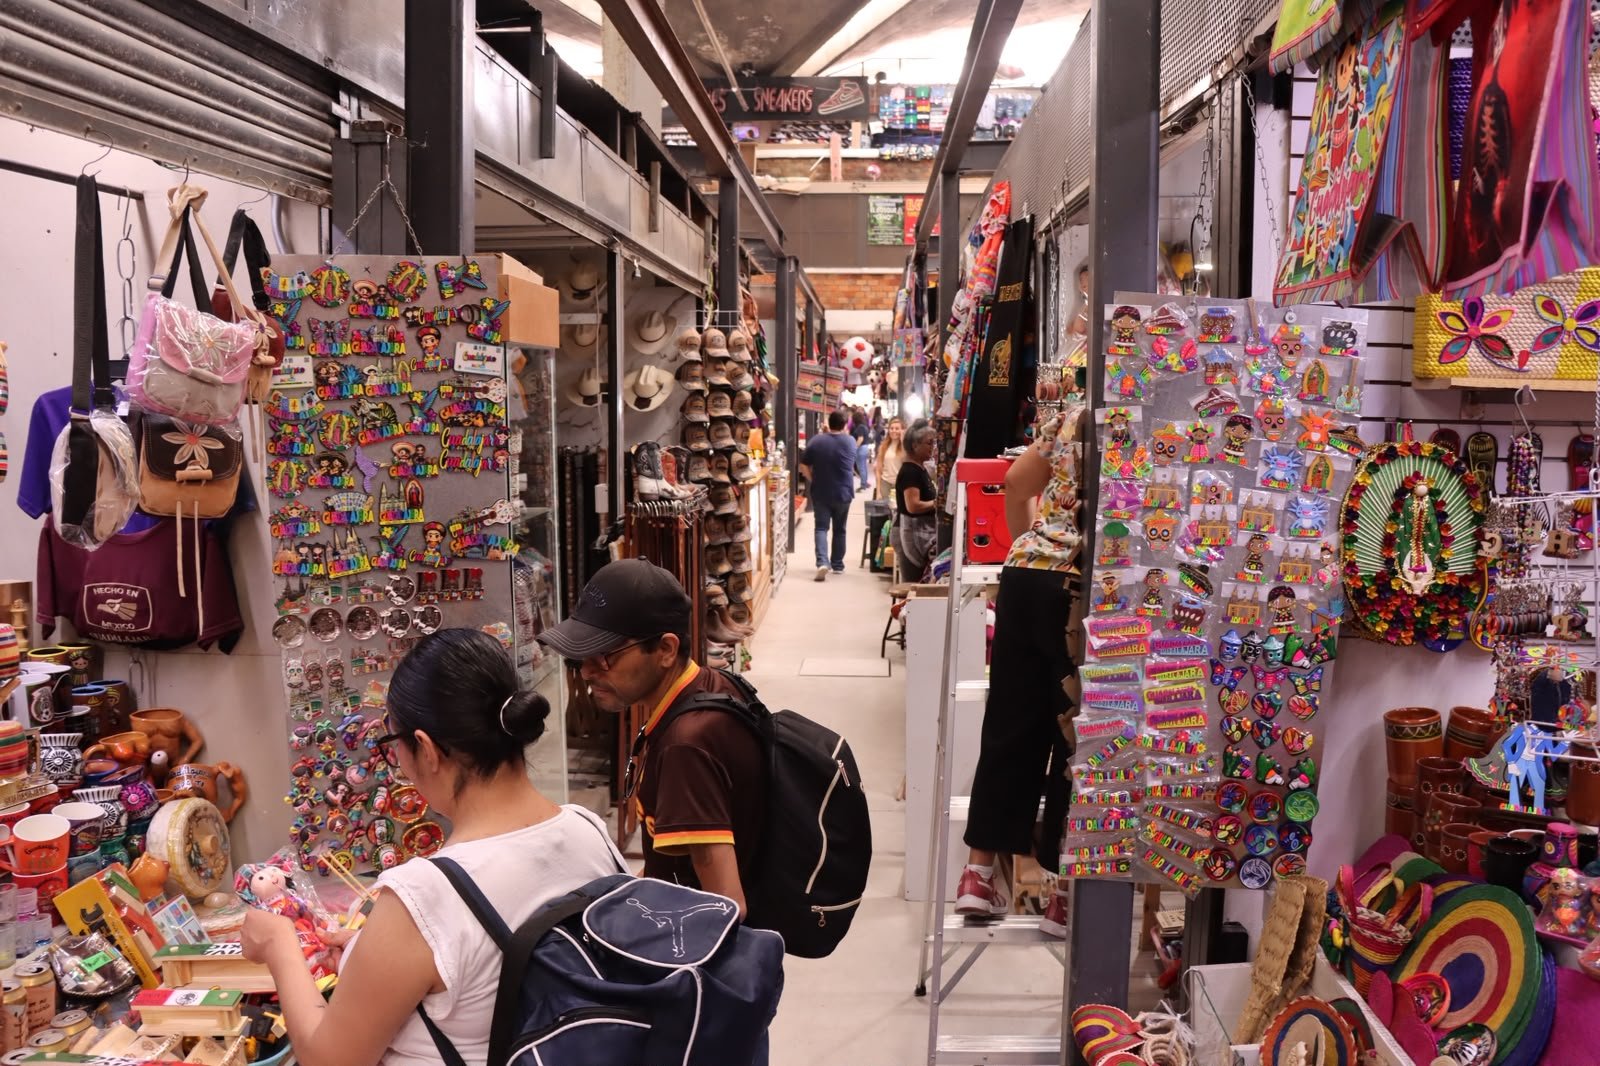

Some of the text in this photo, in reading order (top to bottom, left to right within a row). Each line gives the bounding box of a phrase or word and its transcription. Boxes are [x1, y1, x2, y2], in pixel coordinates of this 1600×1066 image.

[753, 89, 814, 113] SNEAKERS
[93, 587, 140, 598] HECHO EN
[101, 620, 135, 630] MEXICO
